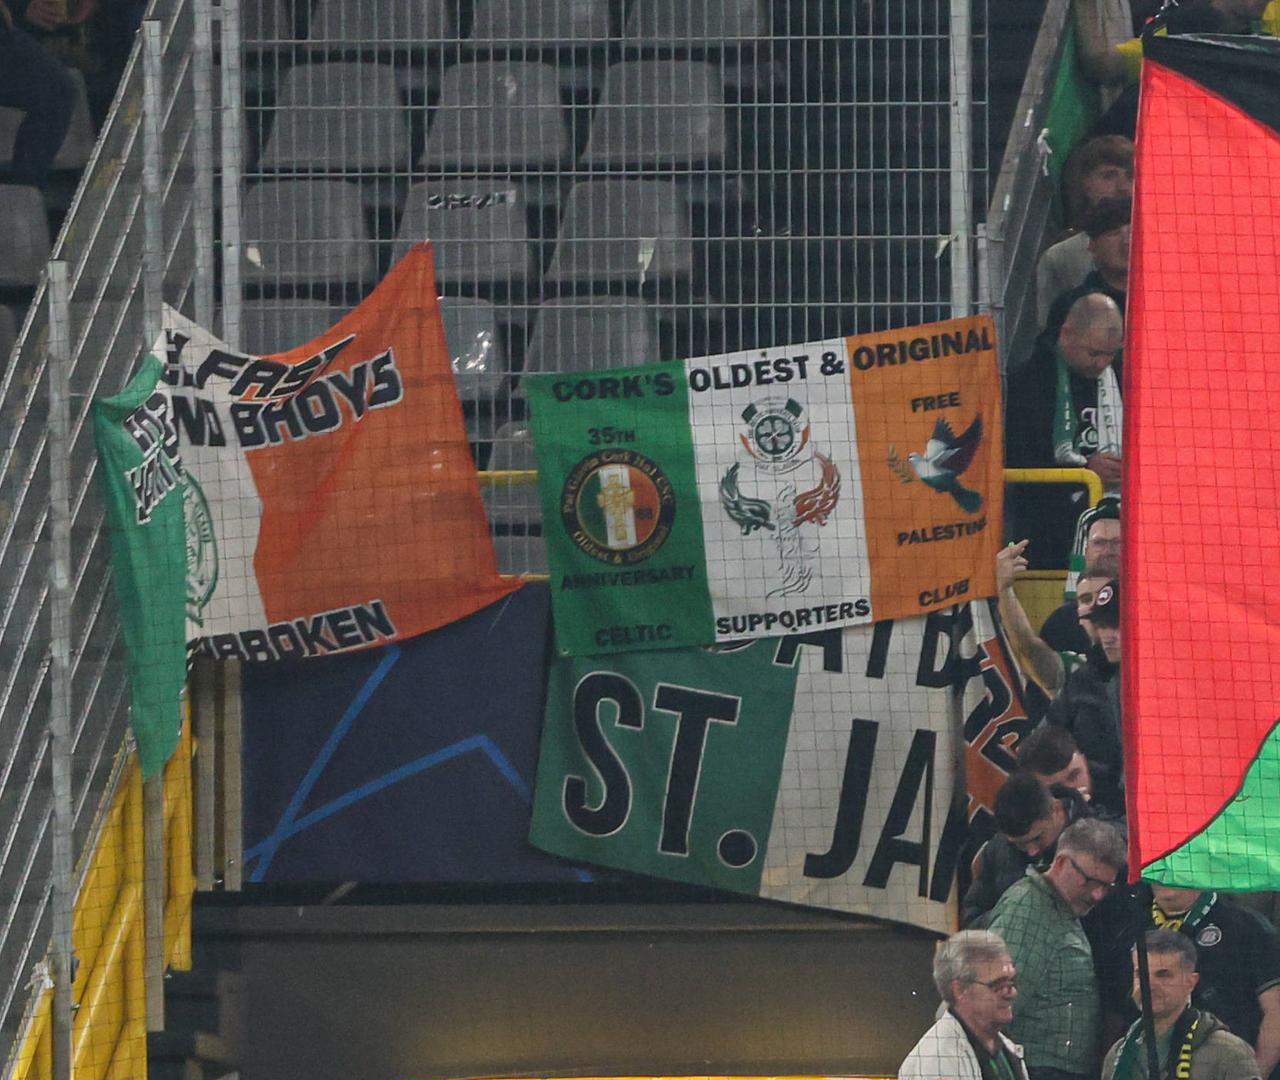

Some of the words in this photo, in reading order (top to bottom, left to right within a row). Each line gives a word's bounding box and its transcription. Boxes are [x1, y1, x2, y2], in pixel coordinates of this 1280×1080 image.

[552, 371, 675, 402] CORK'S
[689, 354, 809, 392] OLDEST
[820, 351, 846, 377] &
[853, 326, 994, 371] ORIGINAL
[233, 347, 403, 447] BHOYS
[911, 391, 960, 412] FREE
[587, 426, 636, 445] 35TH
[560, 564, 695, 591] ANNIVERSARY
[918, 579, 970, 608] CLUB
[716, 598, 871, 635] SUPPORTERS
[594, 622, 673, 648] CELTIC
[562, 670, 758, 868] ST.
